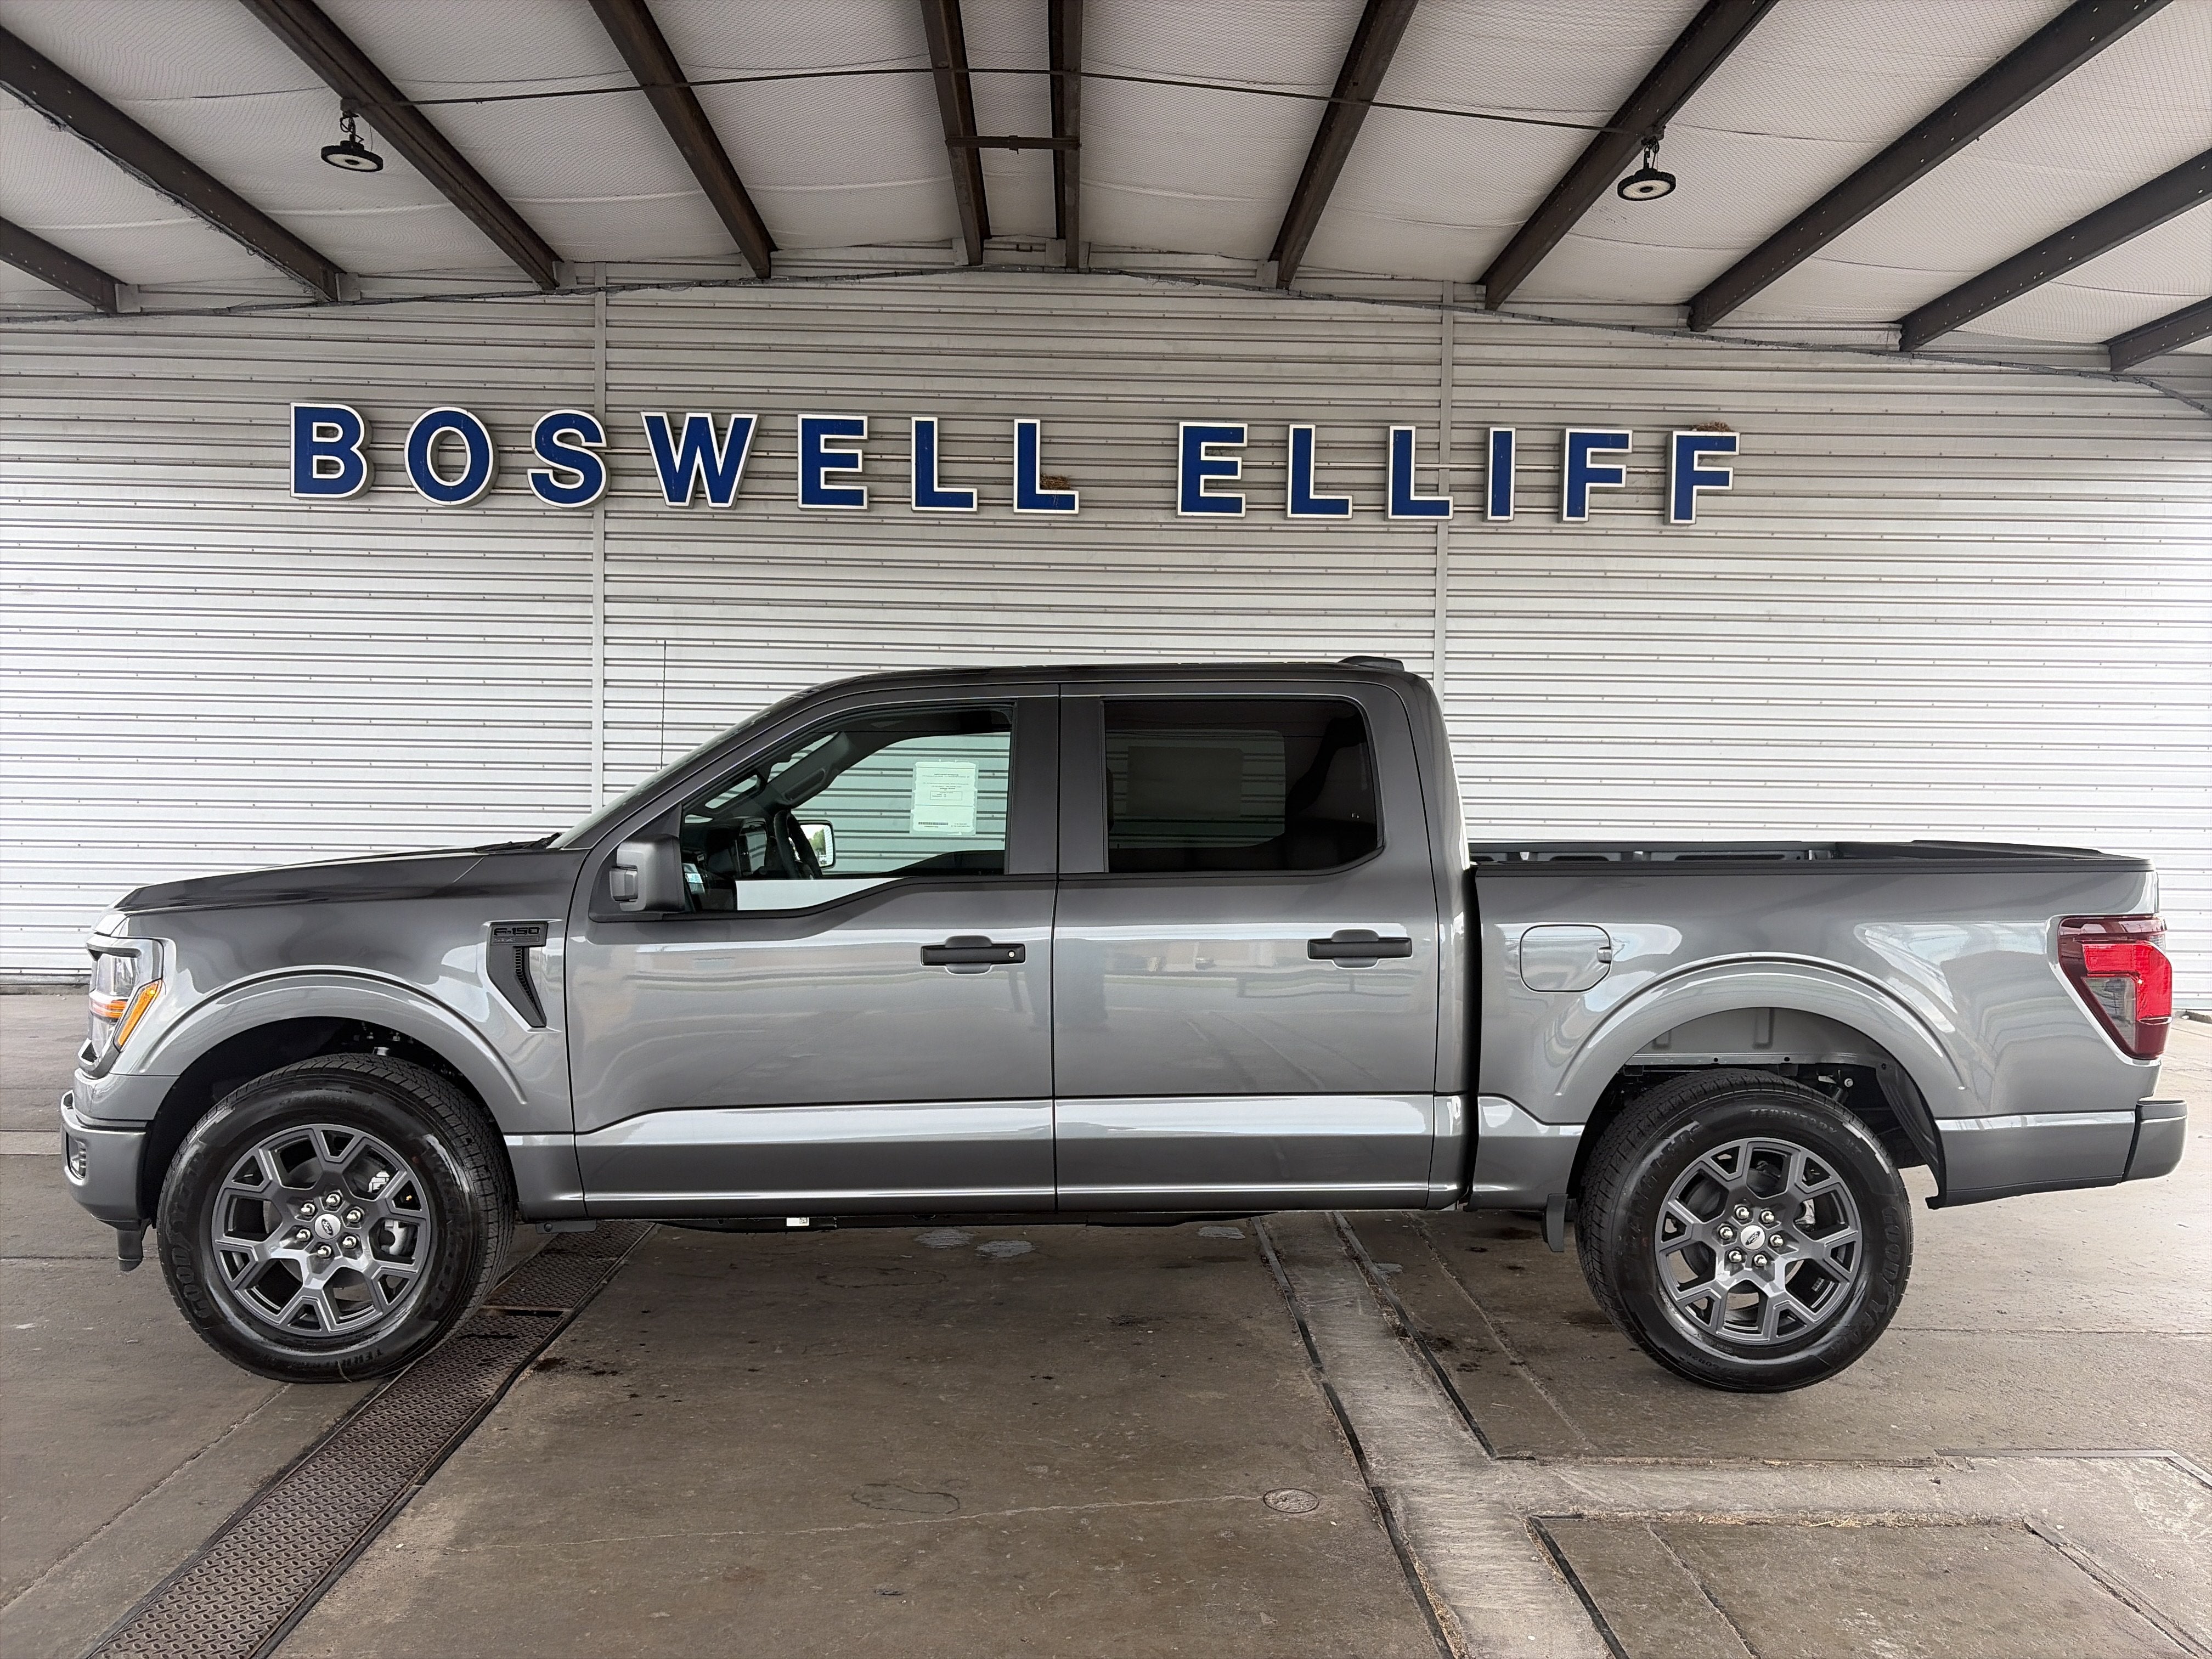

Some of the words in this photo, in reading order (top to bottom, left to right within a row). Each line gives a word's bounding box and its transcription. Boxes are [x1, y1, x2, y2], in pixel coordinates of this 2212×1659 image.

[290, 402, 1079, 514] BOSWELL
[1177, 421, 1740, 525] ELLIFF
[494, 927, 540, 936] F-150
